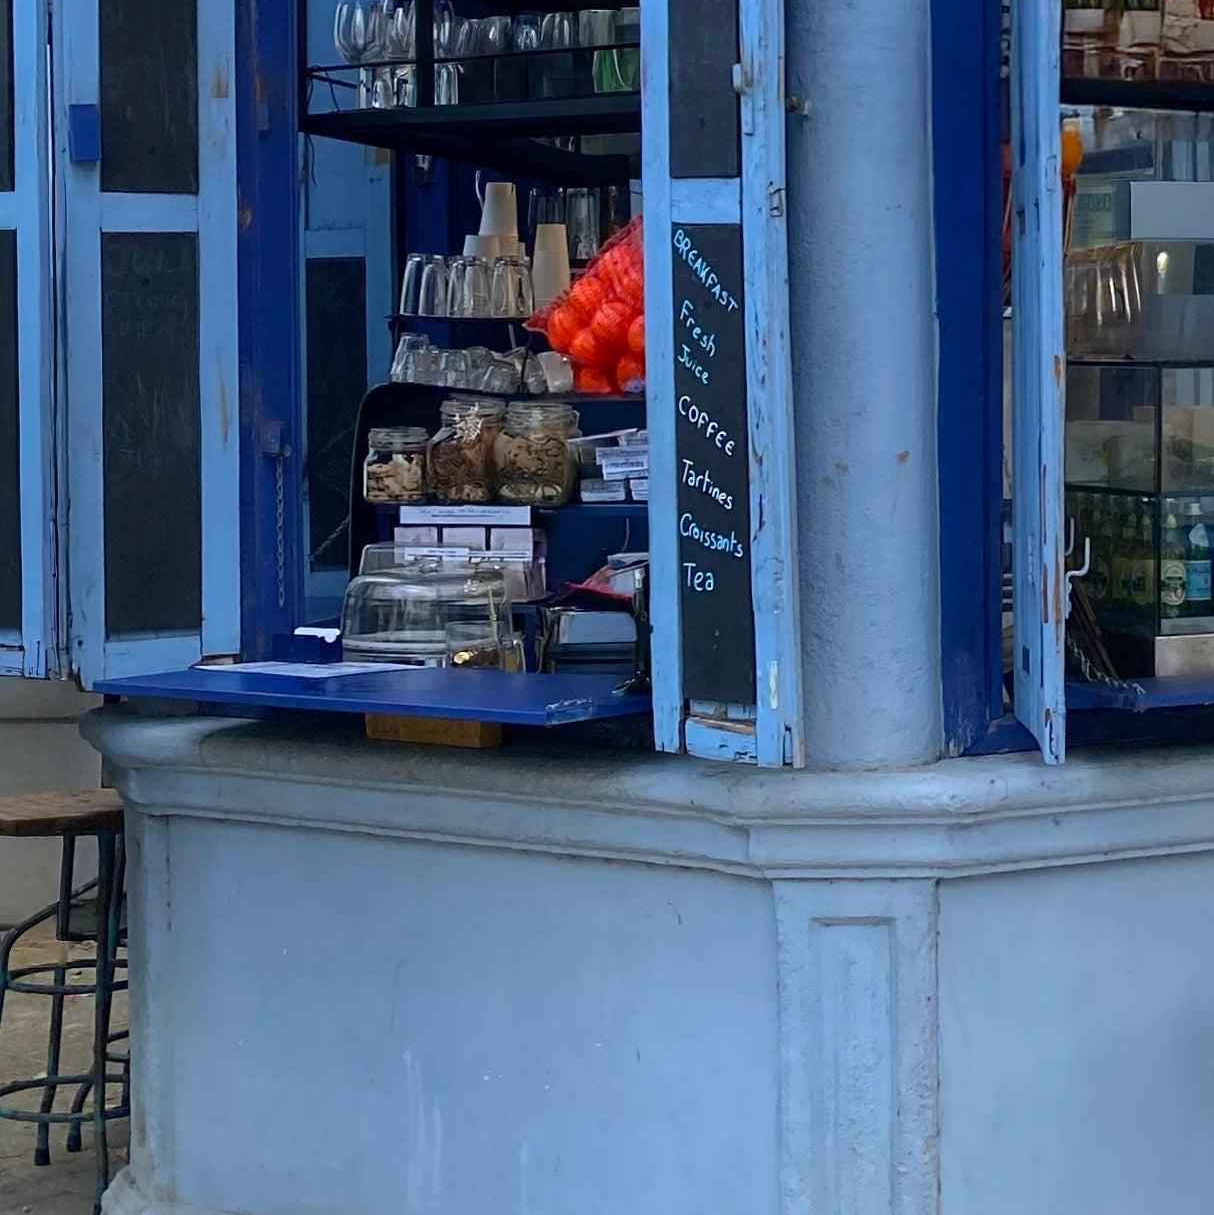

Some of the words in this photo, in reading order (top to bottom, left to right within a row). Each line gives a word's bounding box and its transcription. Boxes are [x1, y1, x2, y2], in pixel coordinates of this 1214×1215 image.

[674, 229, 739, 312] BREAKFAST
[680, 299, 717, 357] Fresh
[677, 344, 710, 384] Juice
[678, 395, 735, 456] COFFEE
[681, 458, 733, 510] Tartines
[679, 513, 744, 558] Croissants
[683, 562, 715, 591] Tea
